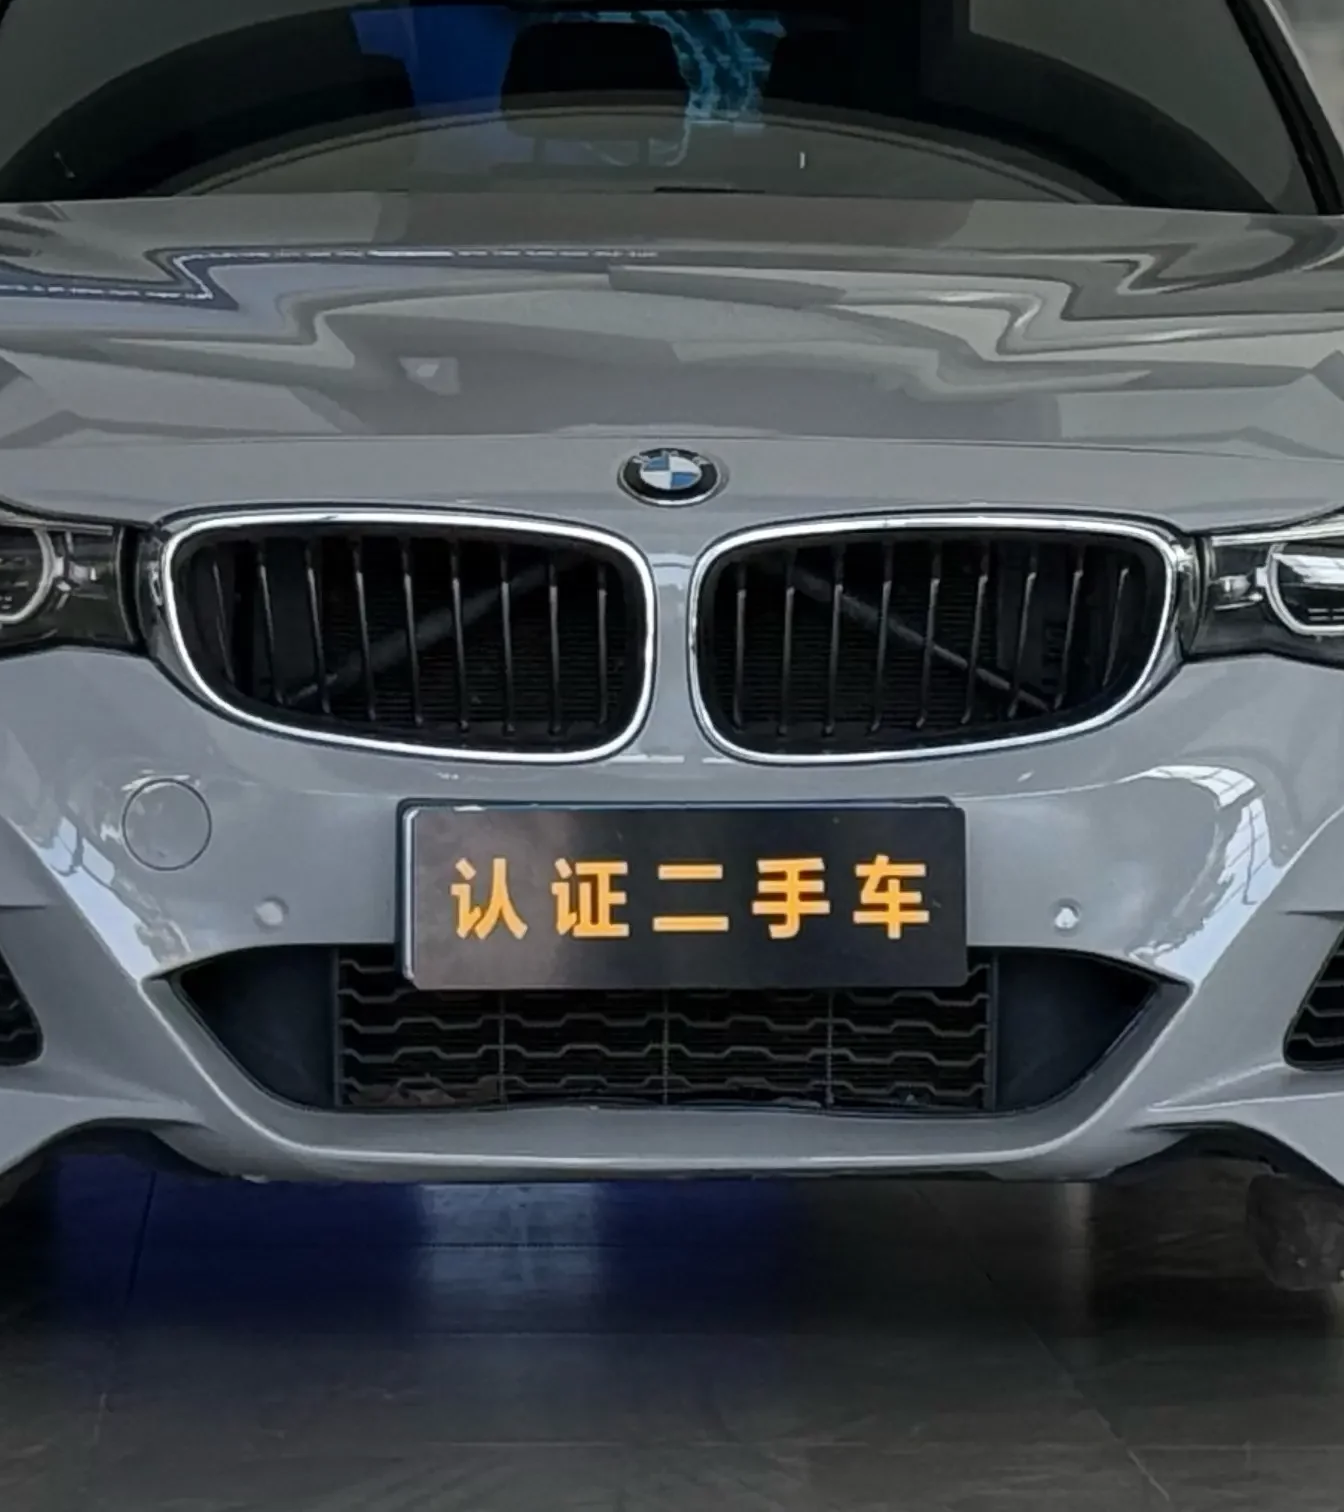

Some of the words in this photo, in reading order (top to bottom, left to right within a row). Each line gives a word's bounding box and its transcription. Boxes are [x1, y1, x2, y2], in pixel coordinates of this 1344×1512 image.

[450, 855, 930, 940] 认证二手车
